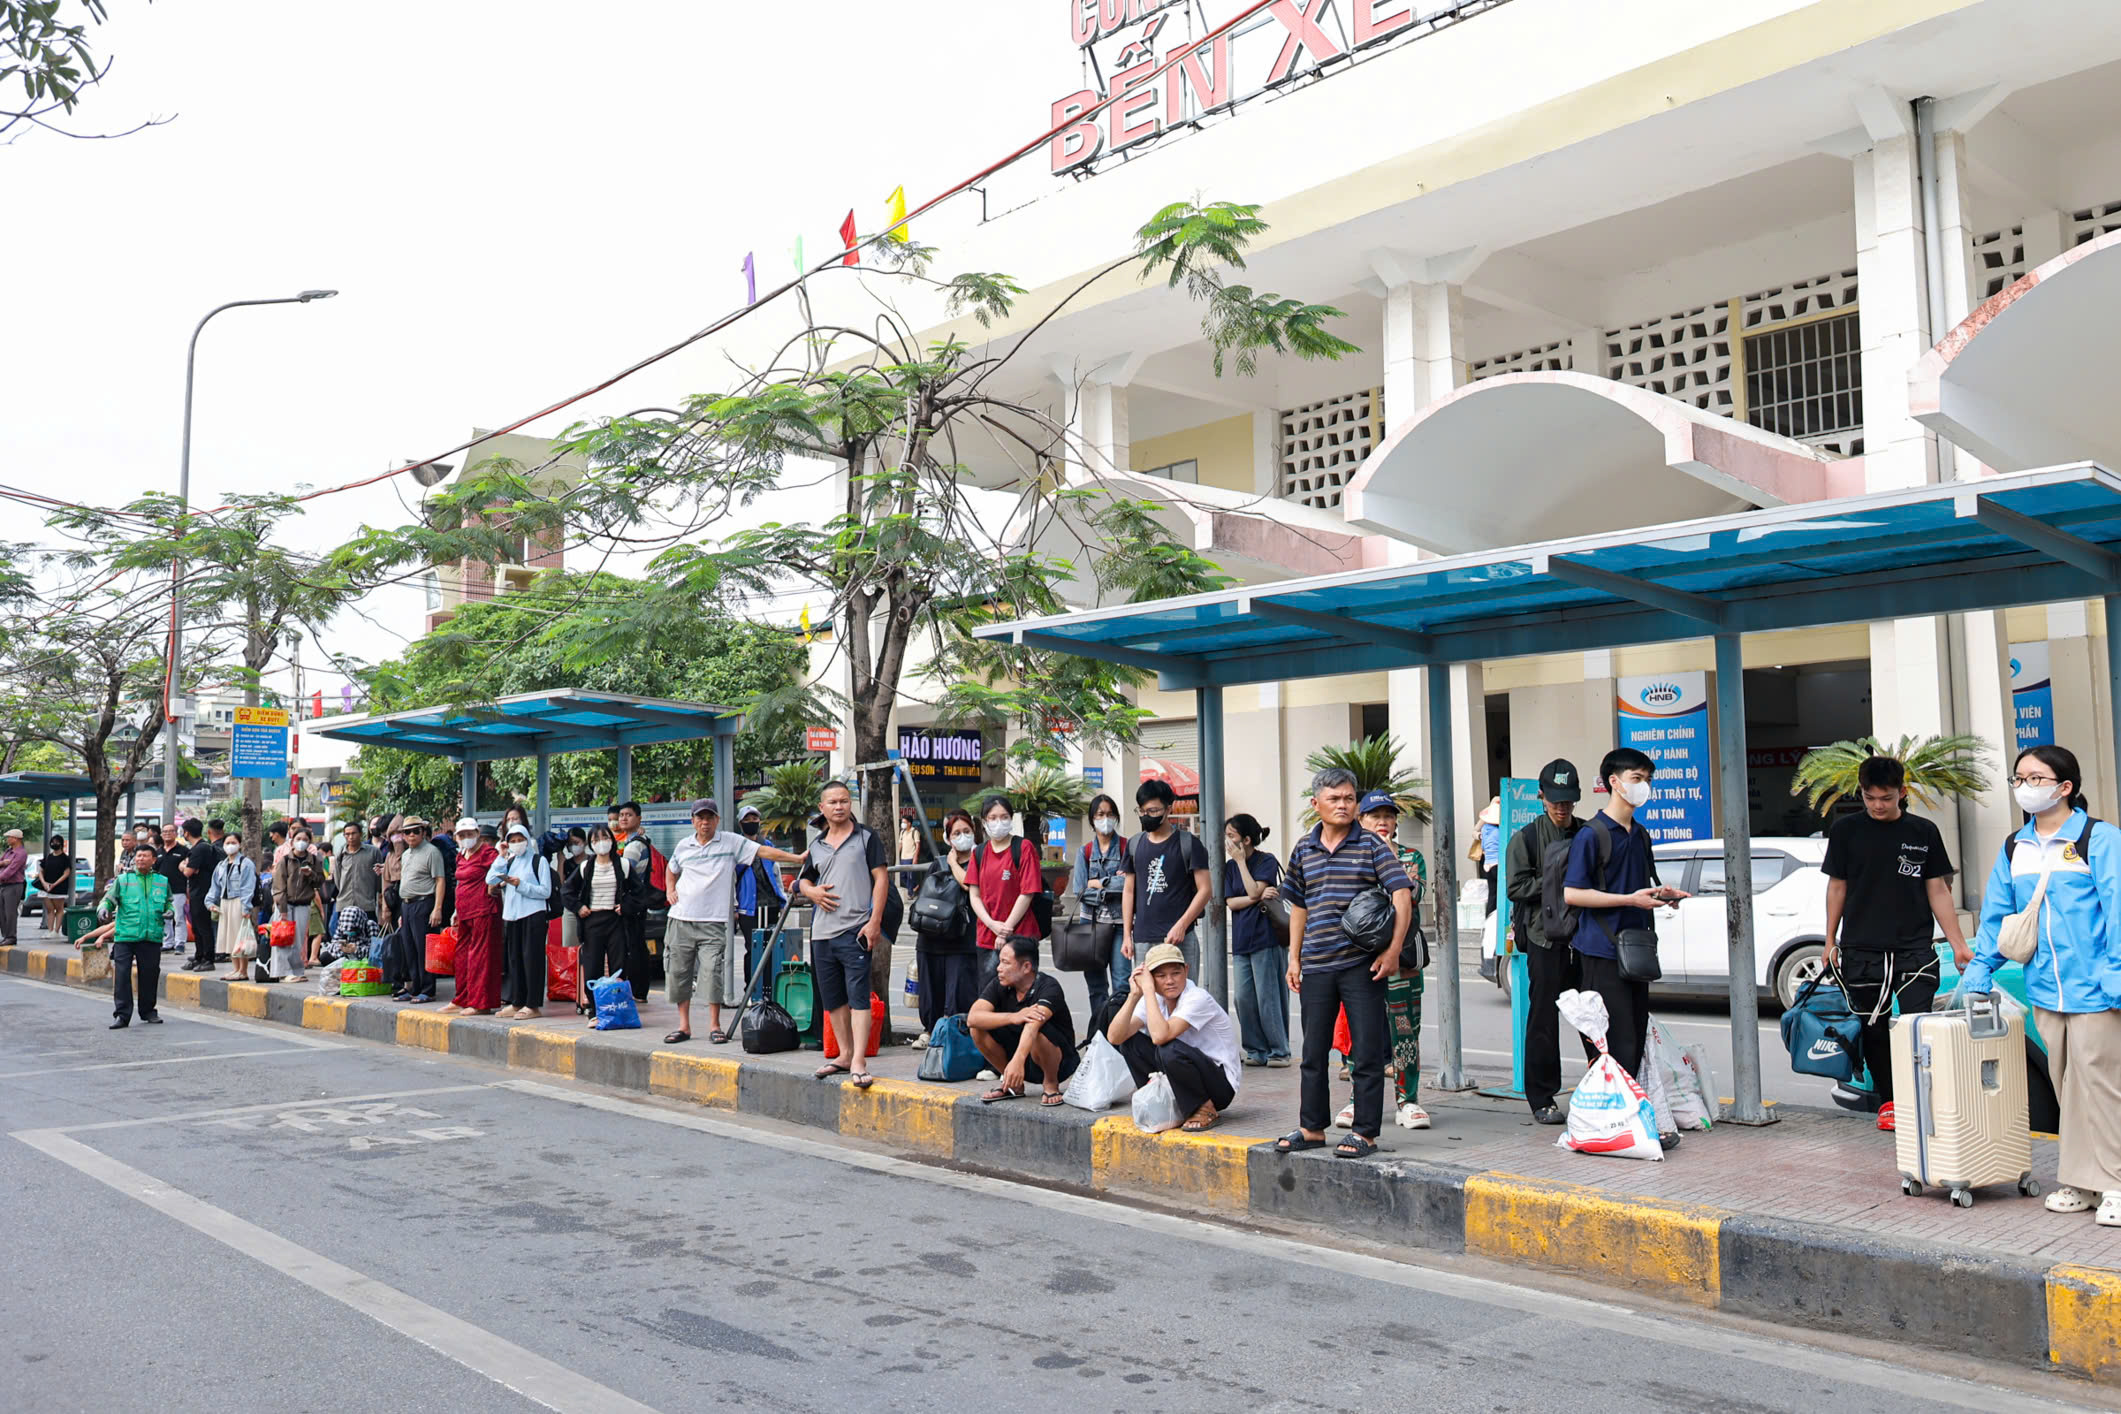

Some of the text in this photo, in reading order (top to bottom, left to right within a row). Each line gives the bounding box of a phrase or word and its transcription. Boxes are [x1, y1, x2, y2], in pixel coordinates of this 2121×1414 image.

[1050, 13, 1234, 176] BẾN
[1649, 693, 1673, 702] HNB
[2019, 704, 2042, 719] VIÊN
[1631, 725, 1695, 741] NGHIÊM CHÍNH
[933, 735, 981, 761] HƯƠNG
[1641, 746, 1689, 760] HẤP HÀNH
[1685, 766, 1698, 781] BỘ
[1664, 786, 1686, 802] TRẬT
[1646, 806, 1685, 820] AN TOÀN
[1662, 826, 1693, 840] THÔNG
[1814, 1038, 1840, 1053] NIKE
